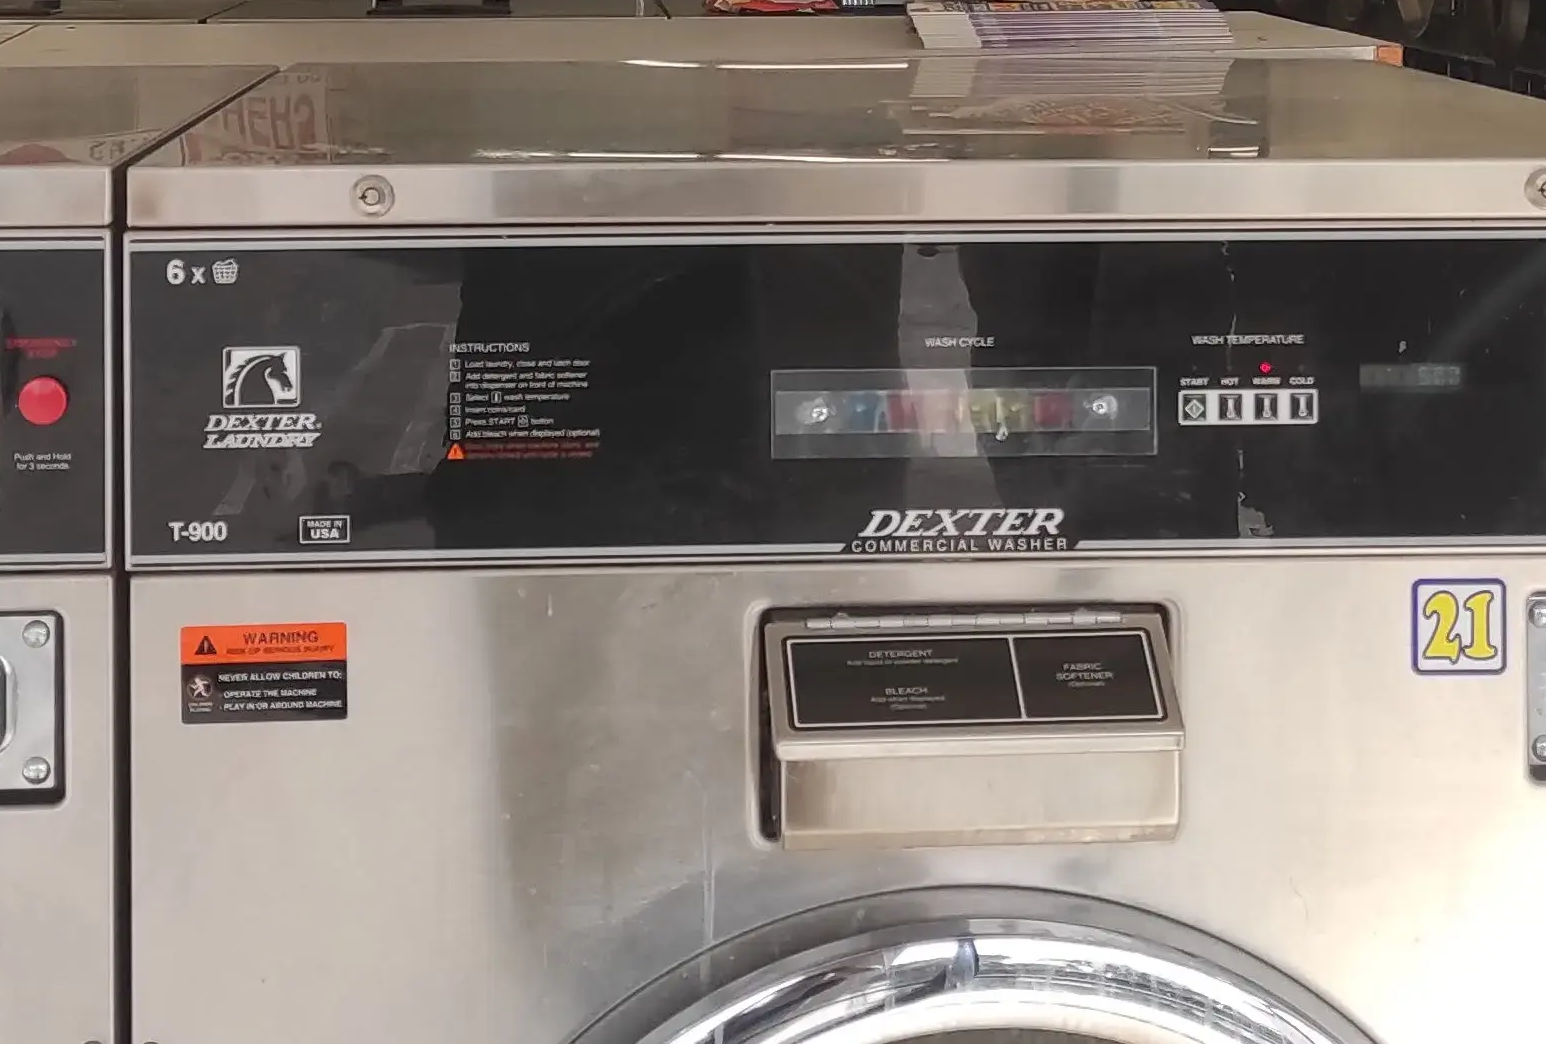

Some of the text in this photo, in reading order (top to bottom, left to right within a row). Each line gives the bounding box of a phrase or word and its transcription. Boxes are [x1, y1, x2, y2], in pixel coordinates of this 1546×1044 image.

[166, 258, 206, 285] 6 x
[924, 337, 995, 347] WASH CYCLE
[1226, 335, 1305, 345] TEMPERATURE
[449, 342, 530, 353] INSTRUCTIONS
[204, 413, 317, 432] DEXTER
[203, 432, 322, 449] LAUNDRY
[307, 520, 342, 529] MADE IN
[857, 508, 1065, 537] DEXTER
[168, 521, 228, 542] T-900
[310, 528, 340, 540] USA
[850, 537, 1068, 553] COMMERCIAL WASHER
[1424, 591, 1497, 666] 21
[243, 630, 319, 645] WARNING
[868, 649, 933, 659] DETERGENT
[1062, 663, 1103, 672] FABRIC
[218, 673, 248, 682] NEVER
[250, 672, 281, 681] ALLOW
[282, 671, 326, 680] CHILDREN
[1056, 671, 1114, 682] SOFTENER
[885, 687, 928, 696] BLEACH
[223, 702, 245, 711] PLAY
